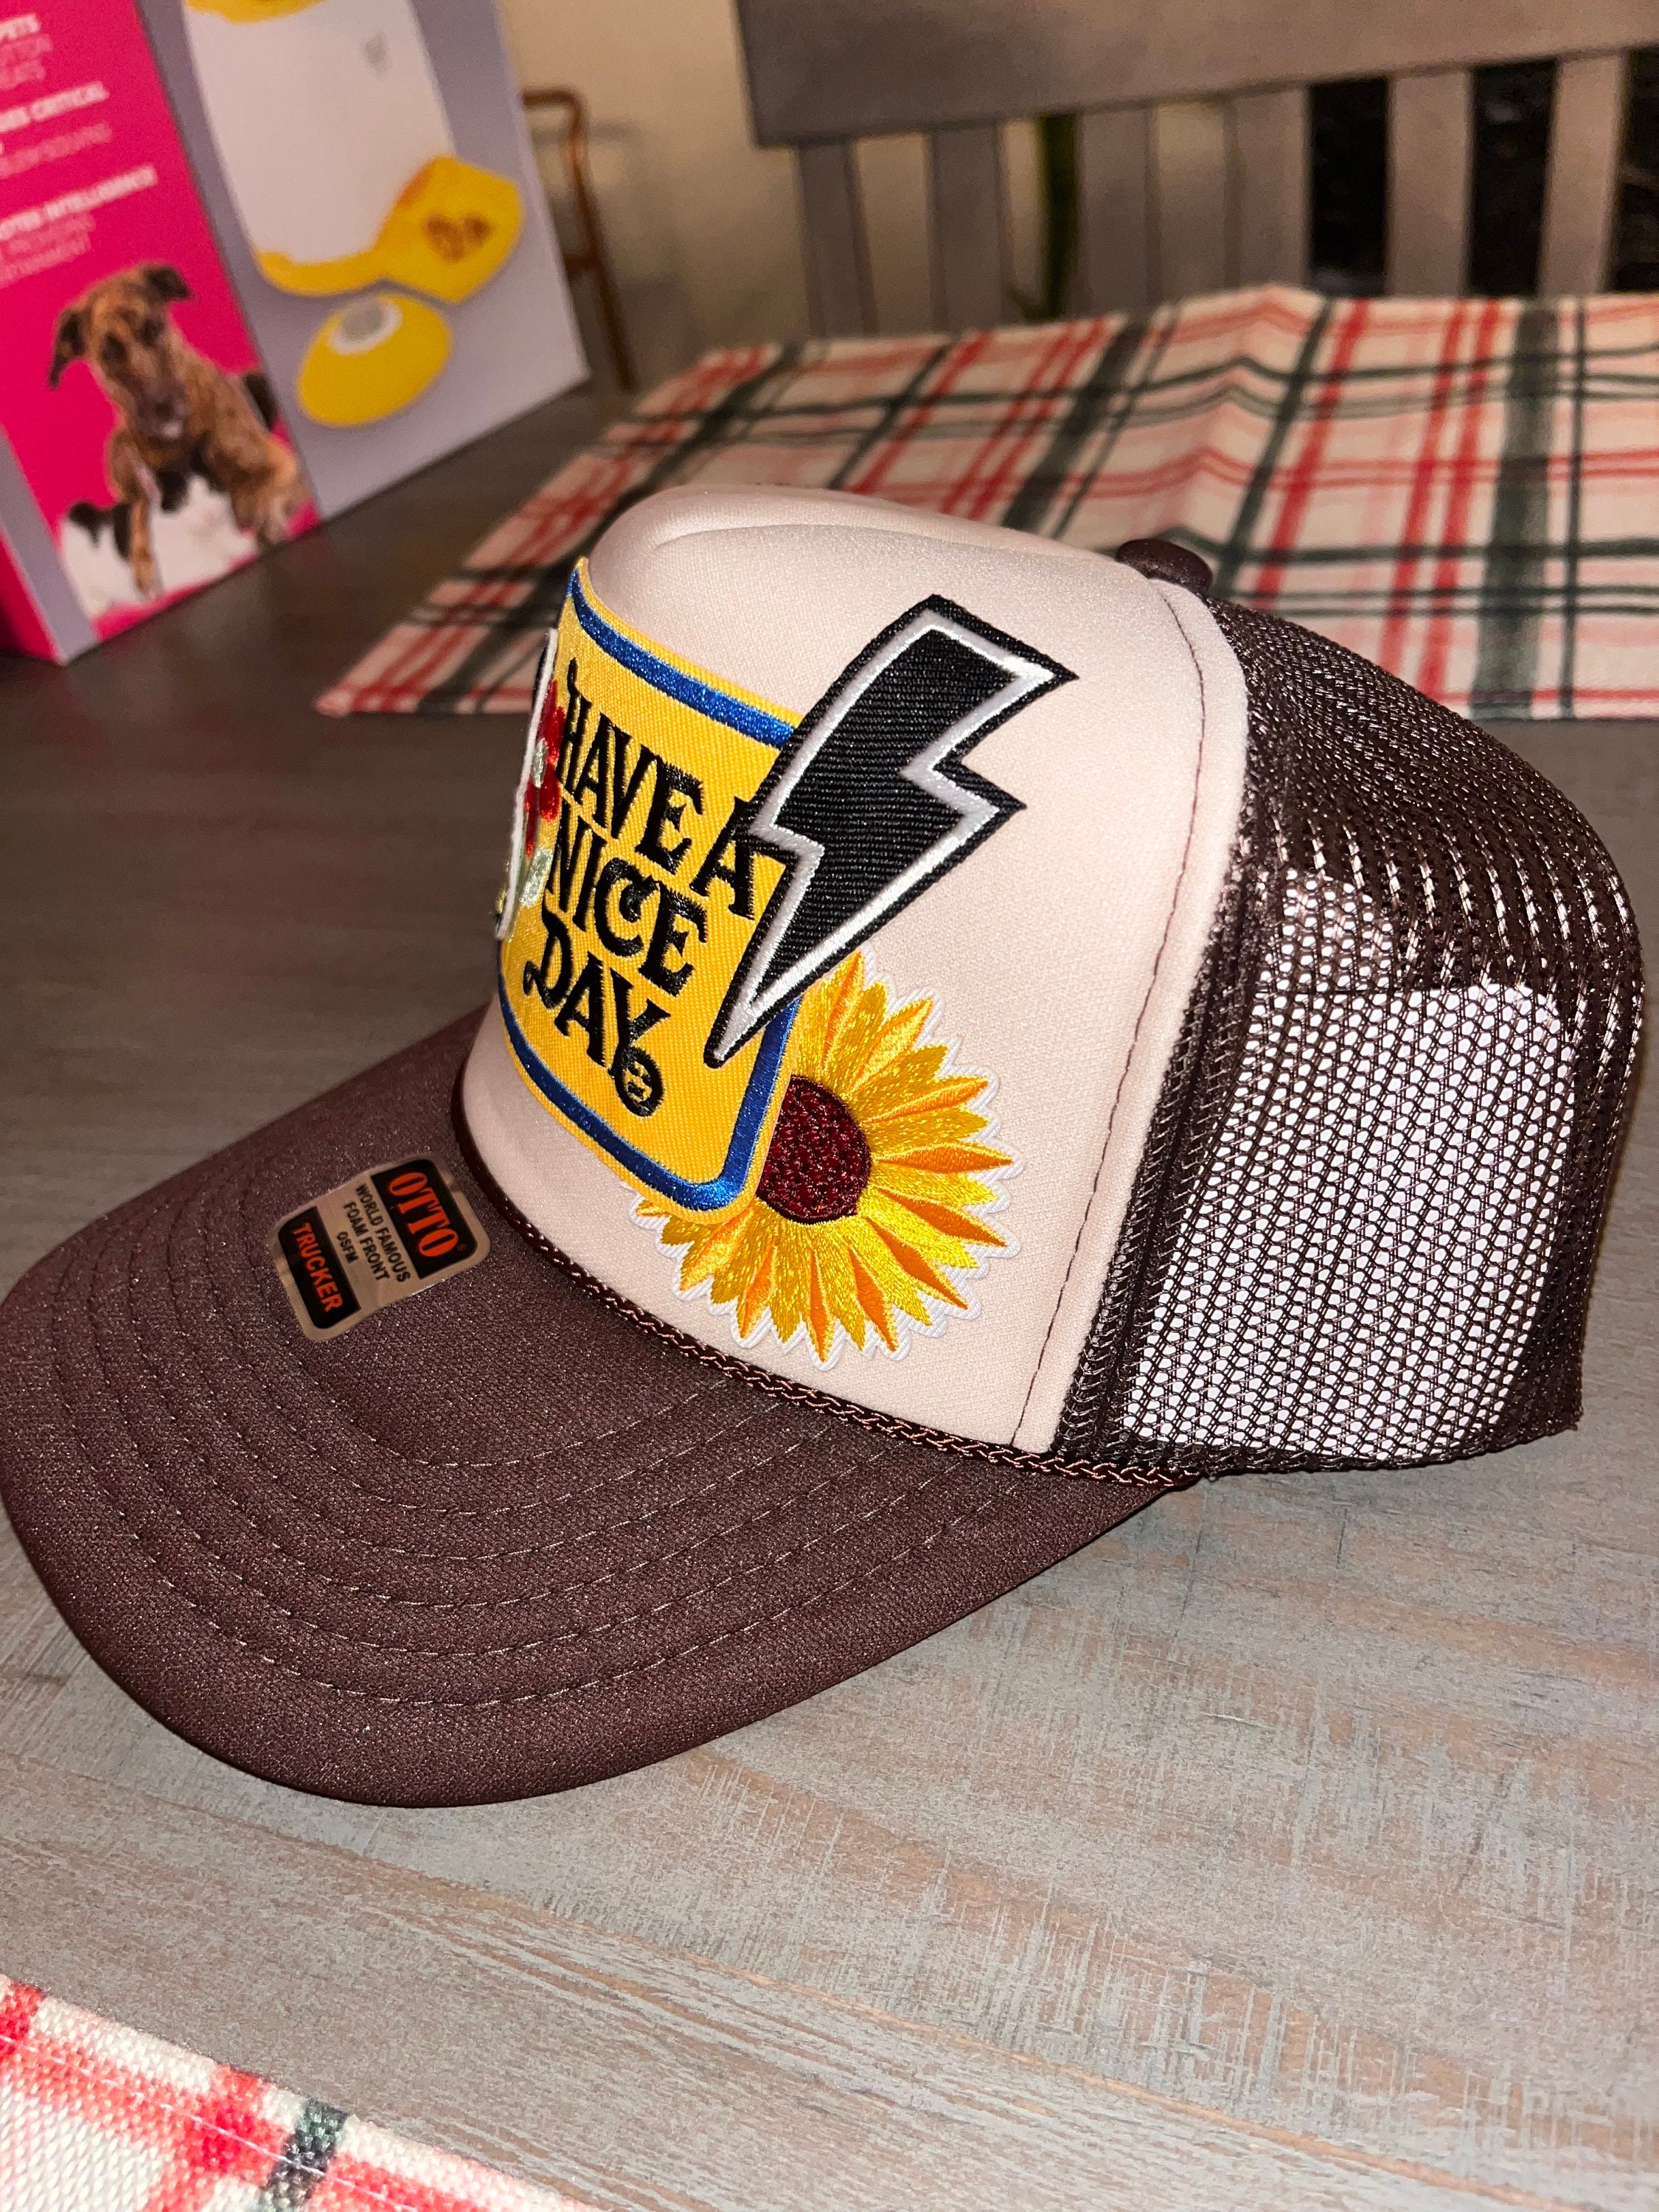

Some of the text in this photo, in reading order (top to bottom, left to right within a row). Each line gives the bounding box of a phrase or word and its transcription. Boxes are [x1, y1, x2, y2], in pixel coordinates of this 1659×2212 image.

[555, 658, 758, 920] HAVE A
[545, 797, 709, 996] NICE
[523, 905, 670, 1117] DAY
[336, 1231, 359, 1264] OSFM
[343, 1200, 390, 1281] FOAM FRONT
[355, 1182, 411, 1282] WORLD FAMOUS
[388, 1171, 459, 1258] OTTO
[293, 1222, 344, 1313] TRUCKER
